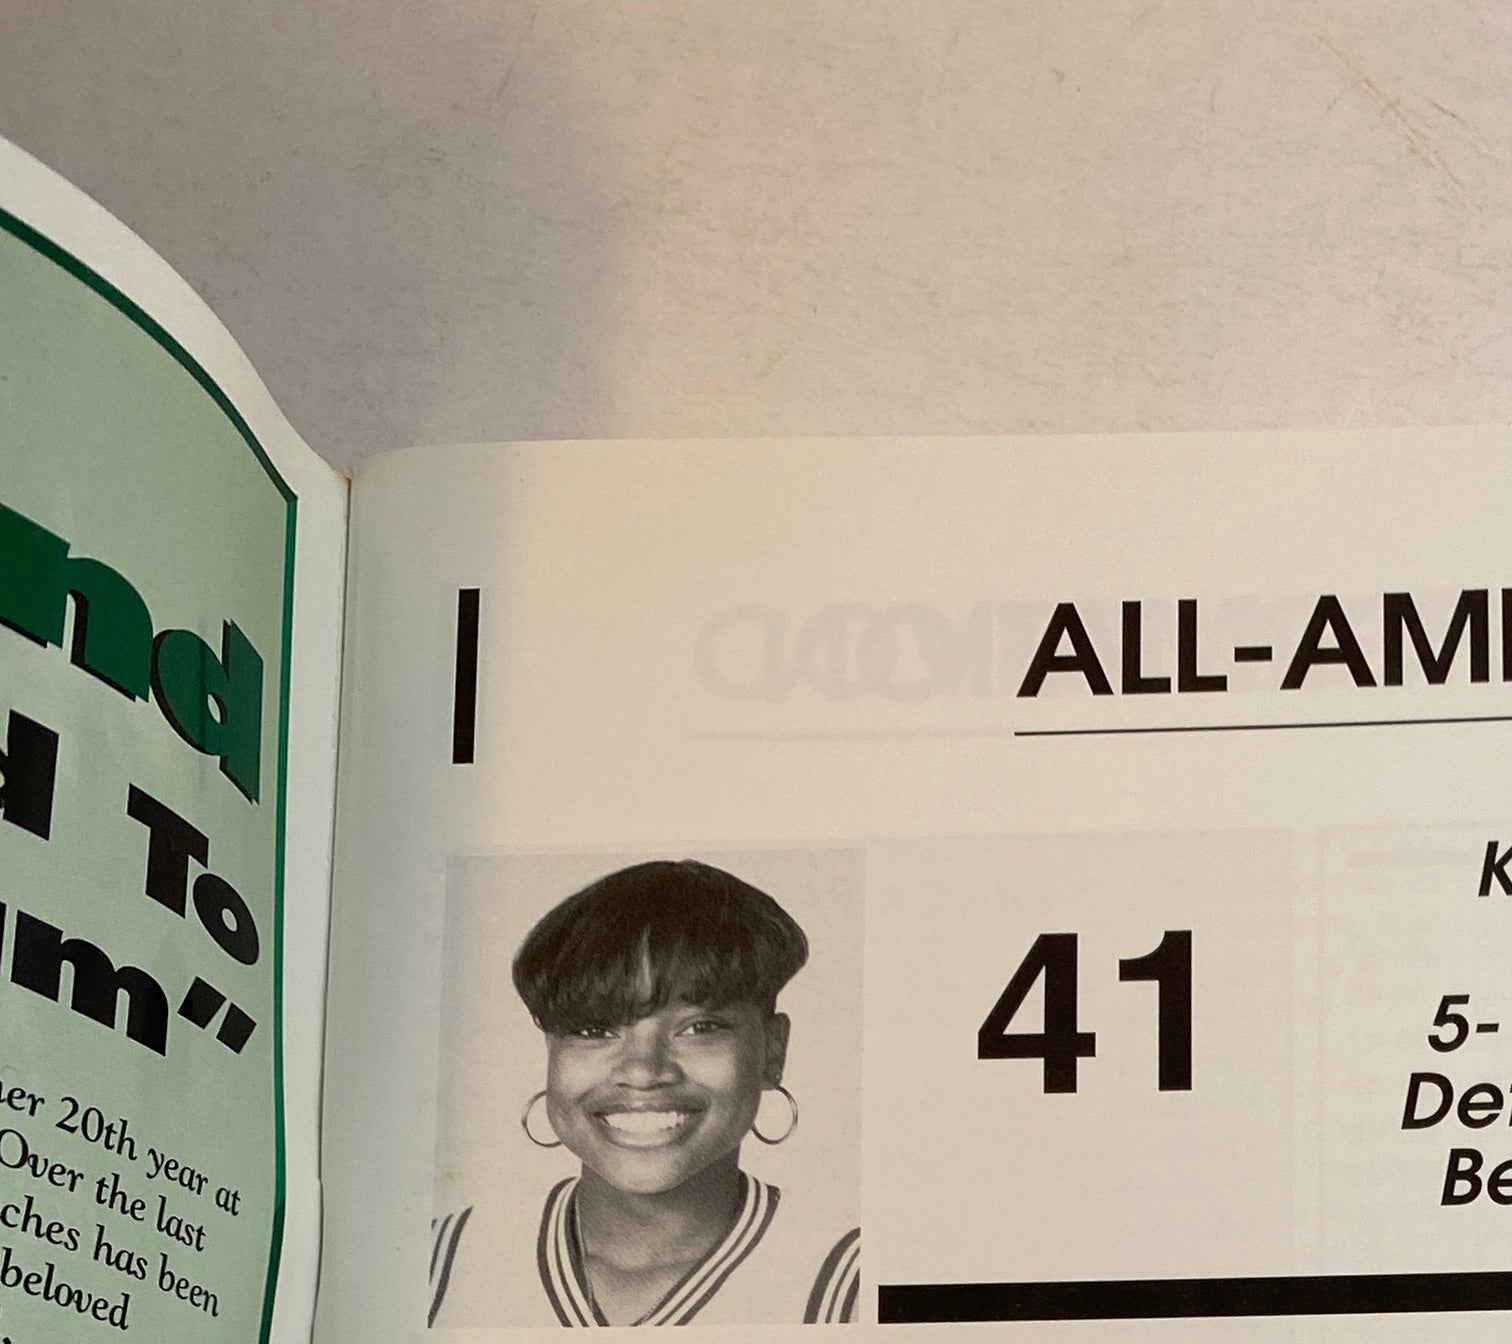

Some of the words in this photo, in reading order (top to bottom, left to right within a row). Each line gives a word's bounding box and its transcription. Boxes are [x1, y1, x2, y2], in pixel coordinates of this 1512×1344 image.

[127, 783, 259, 966] To
[978, 930, 1192, 1094] 41
[0, 1129, 84, 1192] Over
[96, 1172, 146, 1221] the
[156, 1194, 206, 1252] last
[55, 1097, 137, 1161] 20th
[146, 1148, 208, 1195] year
[215, 1187, 241, 1216] at
[1, 1195, 81, 1251] ches
[93, 1224, 148, 1280] has
[158, 1252, 219, 1318] been
[1, 1246, 130, 1330] beloved
